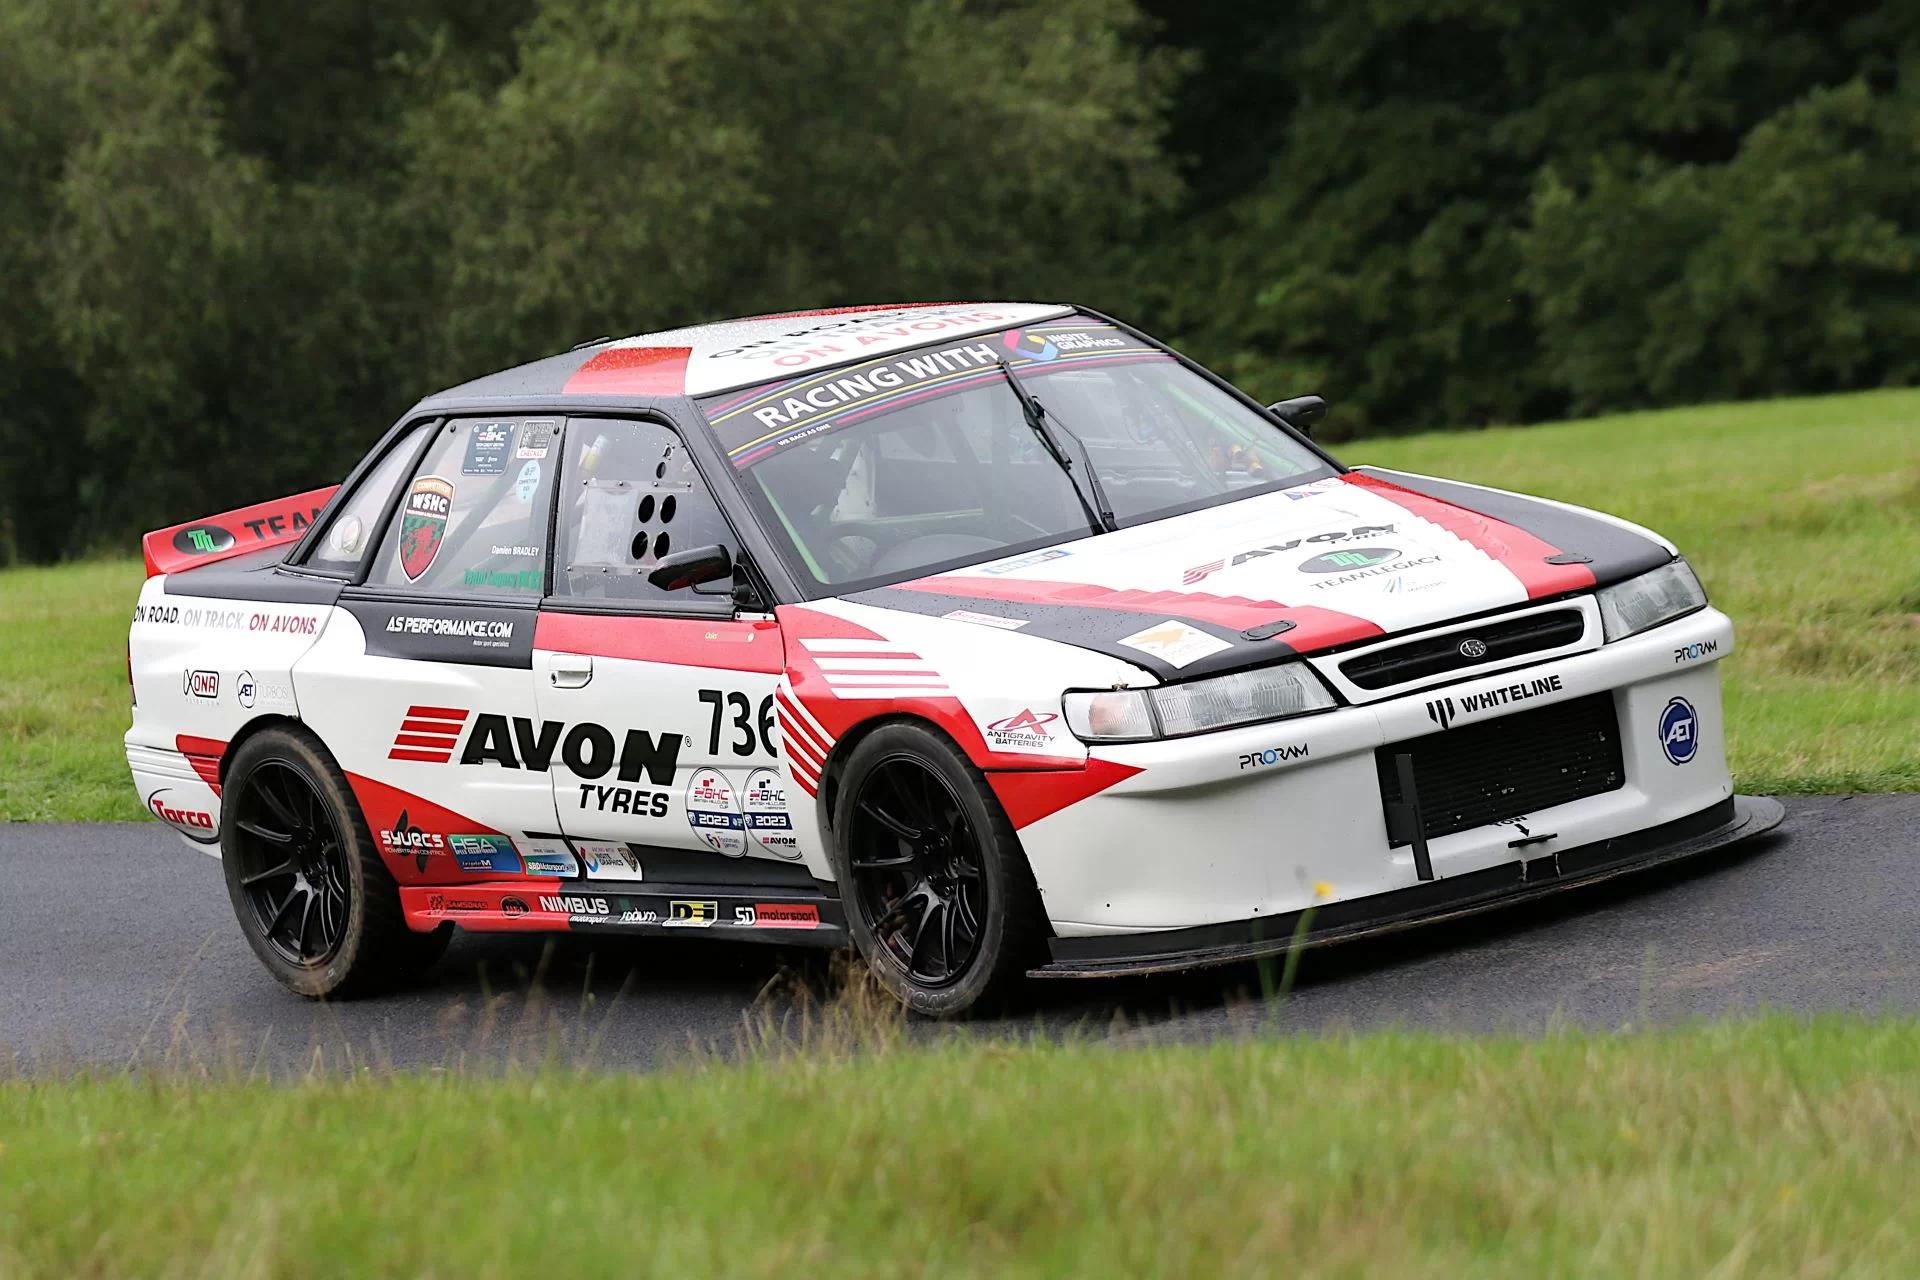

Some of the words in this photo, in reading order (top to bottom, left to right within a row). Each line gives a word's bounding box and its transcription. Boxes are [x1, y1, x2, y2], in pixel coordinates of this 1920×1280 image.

[773, 345, 845, 366] ON
[753, 366, 904, 429] RACING
[896, 343, 1000, 379] WITH
[777, 438, 789, 446] WE
[790, 432, 808, 443] RACE
[808, 427, 817, 435] AS
[817, 422, 832, 433] ONE
[412, 493, 448, 513] WSHC
[491, 545, 512, 556] Damien
[512, 546, 539, 557] BRADLEY
[1232, 524, 1394, 566] AVON
[133, 606, 147, 622] ON
[148, 606, 180, 625] ROAD.
[183, 609, 202, 626] ON
[205, 610, 245, 630] TRACK.
[249, 613, 269, 631] ON
[270, 615, 317, 636] AVONS.
[386, 616, 404, 632] AS
[404, 617, 513, 638] PERFORMANCE.COM
[1674, 640, 1717, 663] PRORAM
[1460, 675, 1562, 712] WHITELINE
[698, 689, 778, 758] 736
[987, 731, 1055, 741] ANTIGRAVITY
[995, 738, 1044, 747] BATTERIES
[460, 712, 684, 786] AVON
[1239, 743, 1309, 769] PRORAM
[579, 783, 670, 818] TYRES
[704, 788, 729, 801] BHC
[760, 790, 785, 802] BHC
[699, 814, 729, 828] 2023
[756, 816, 787, 827] 2023
[450, 838, 497, 853] HSA
[770, 837, 796, 845] AVON
[540, 896, 609, 914] NIMBUS
[759, 911, 817, 921] motorsport
